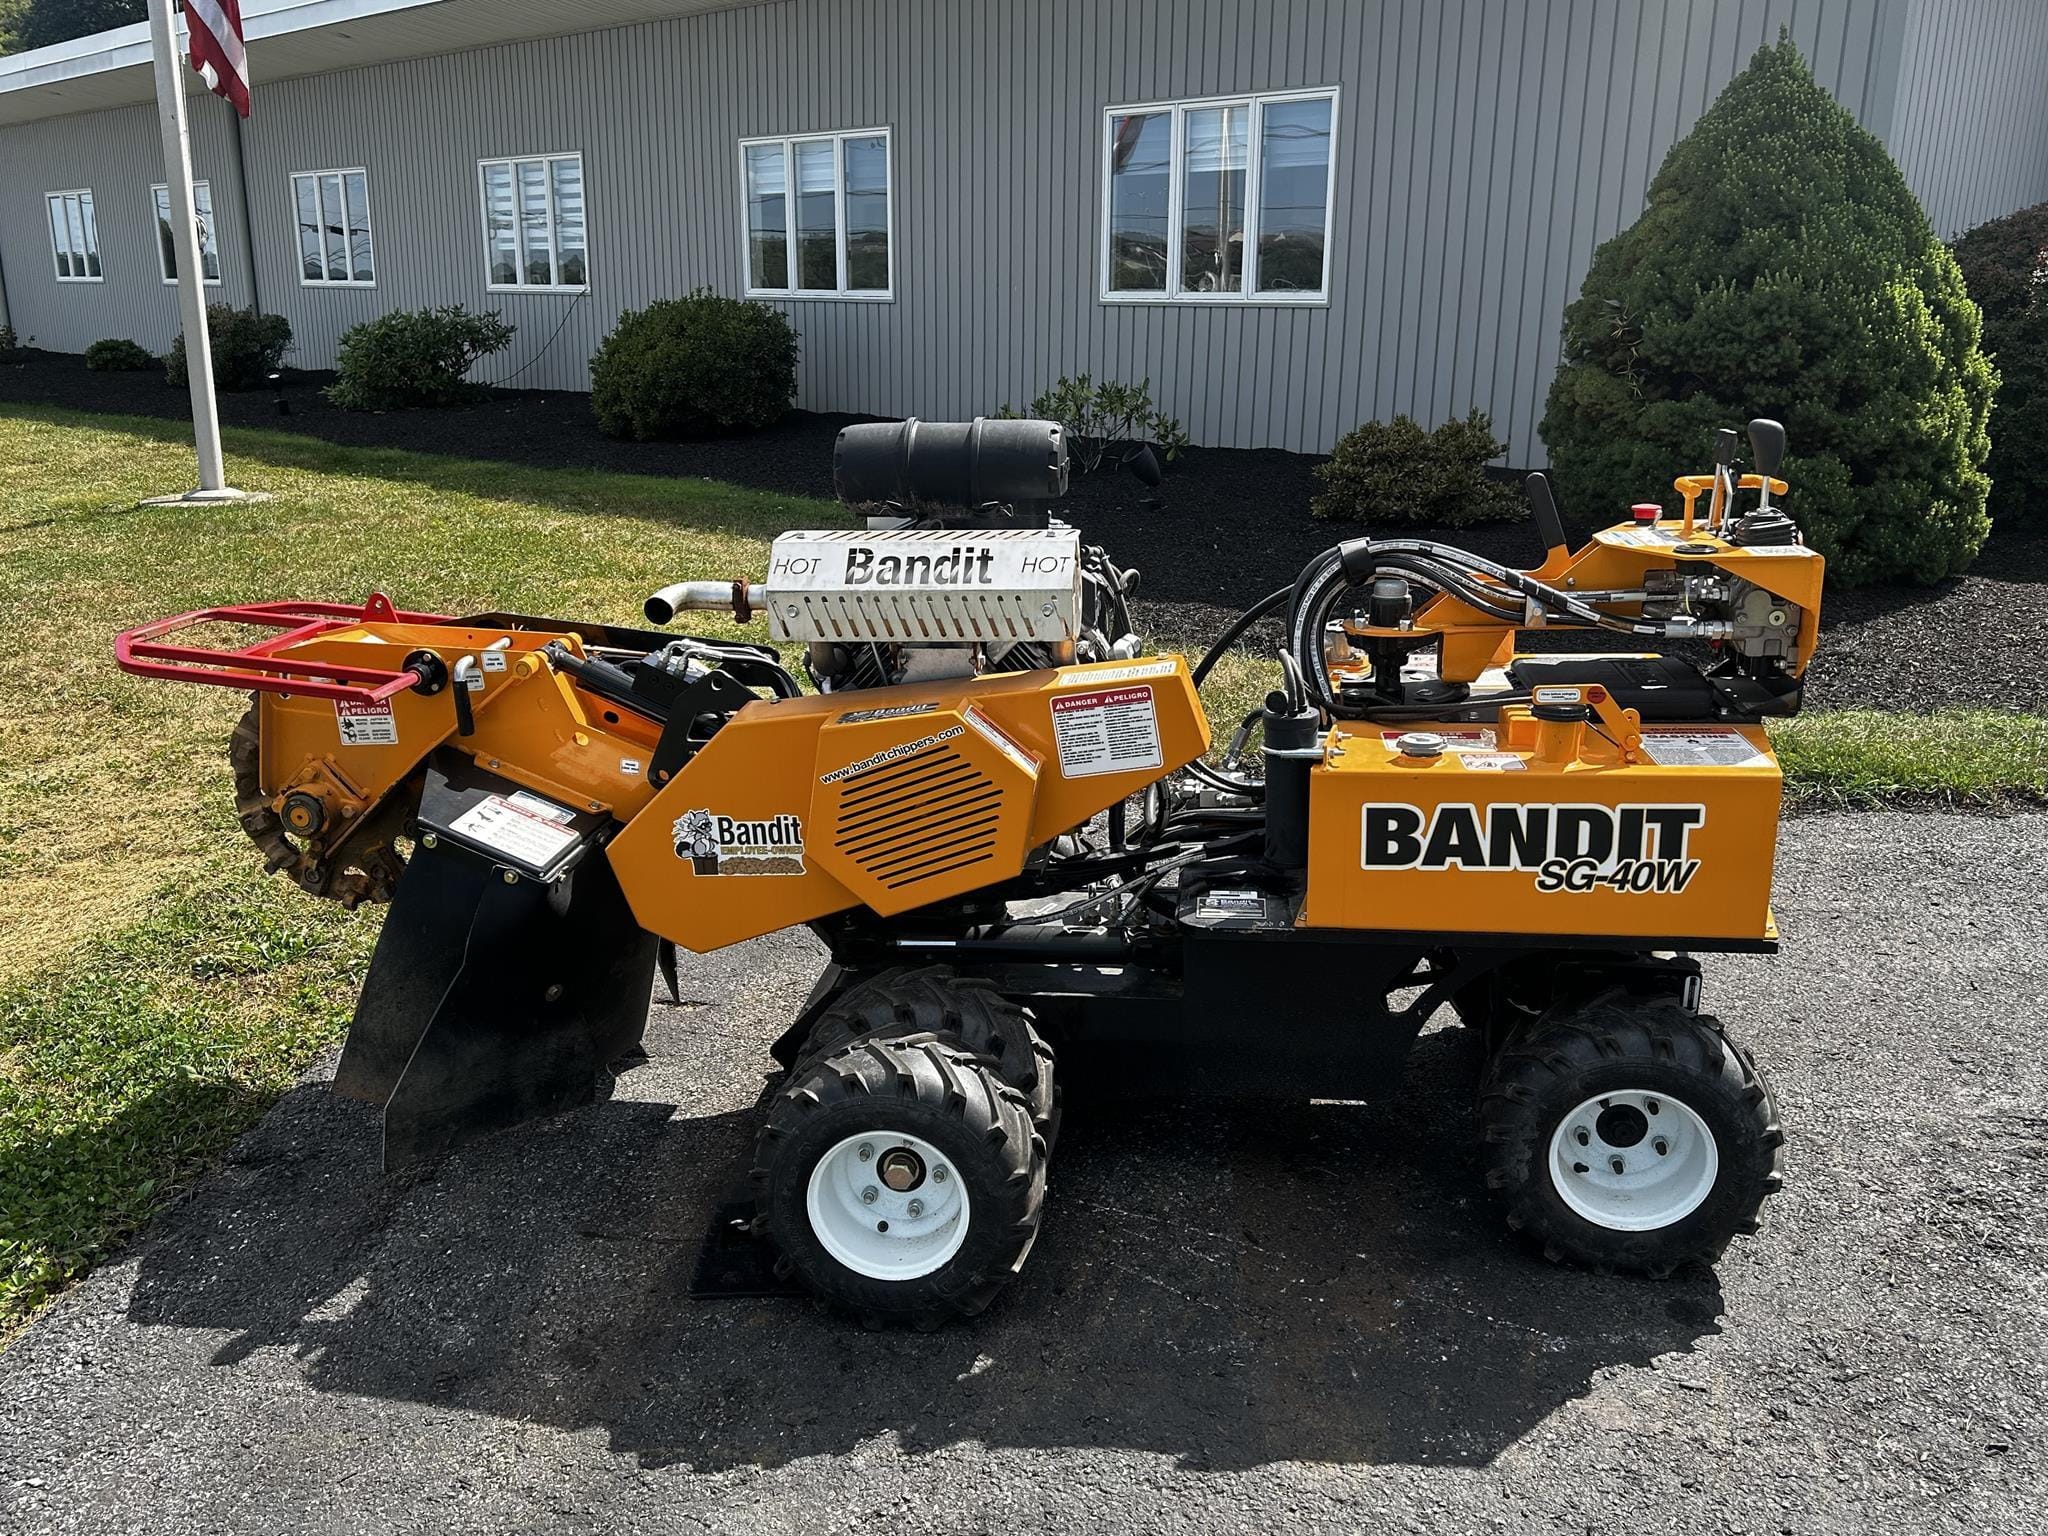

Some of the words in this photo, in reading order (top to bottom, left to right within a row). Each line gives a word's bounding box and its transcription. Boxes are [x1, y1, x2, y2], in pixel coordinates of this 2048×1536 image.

[773, 558, 822, 575] HOT
[844, 547, 994, 585] Bandit
[1021, 556, 1071, 574] HOT
[351, 707, 389, 715] PELIGRO
[1065, 698, 1098, 708] DANGER
[1114, 691, 1149, 702] PELIGRO
[821, 726, 964, 783] www.banditchippers.com
[717, 816, 803, 845] Bandit
[1365, 808, 1701, 866] BANDIT
[720, 846, 804, 856] EMPLOYEE-OWNED
[1537, 860, 1701, 892] SG-40W
